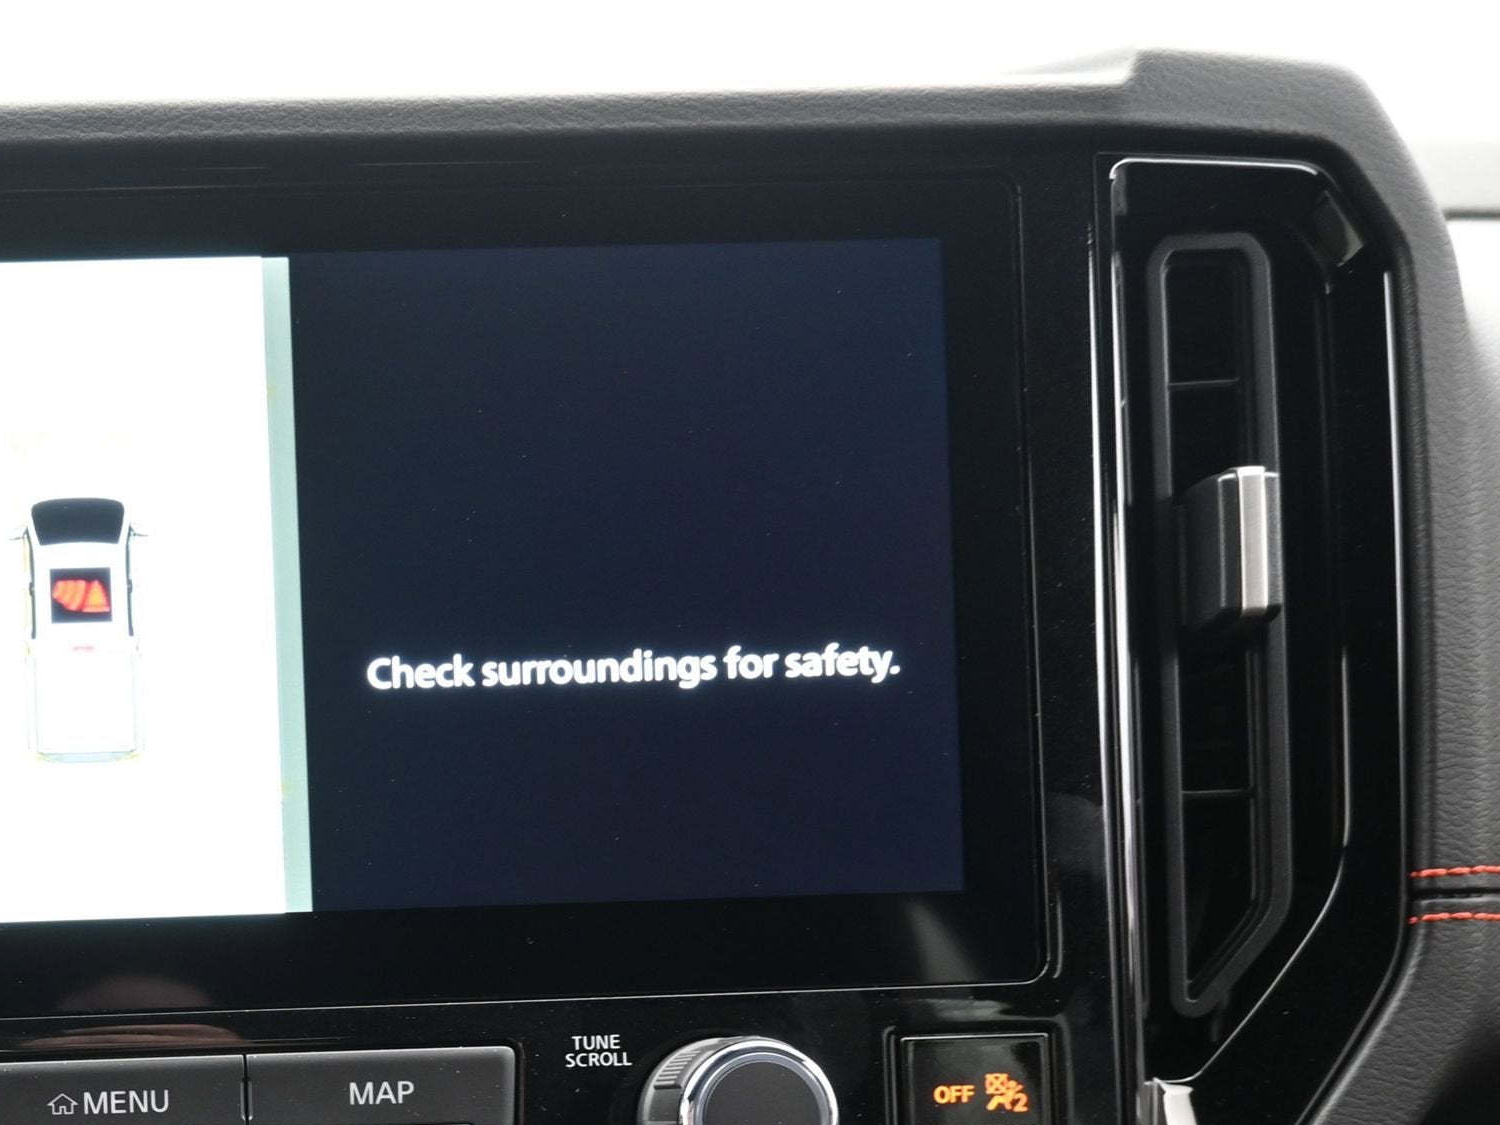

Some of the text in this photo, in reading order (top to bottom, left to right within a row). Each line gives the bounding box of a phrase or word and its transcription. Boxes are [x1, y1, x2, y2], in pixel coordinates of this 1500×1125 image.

[367, 642, 900, 690] Check surroundings for safety.
[572, 1034, 621, 1050] TUNE
[565, 1051, 633, 1068] SCROLL
[83, 1089, 170, 1115] MENU
[348, 1080, 415, 1106] MAP
[933, 1085, 975, 1104] OFF
